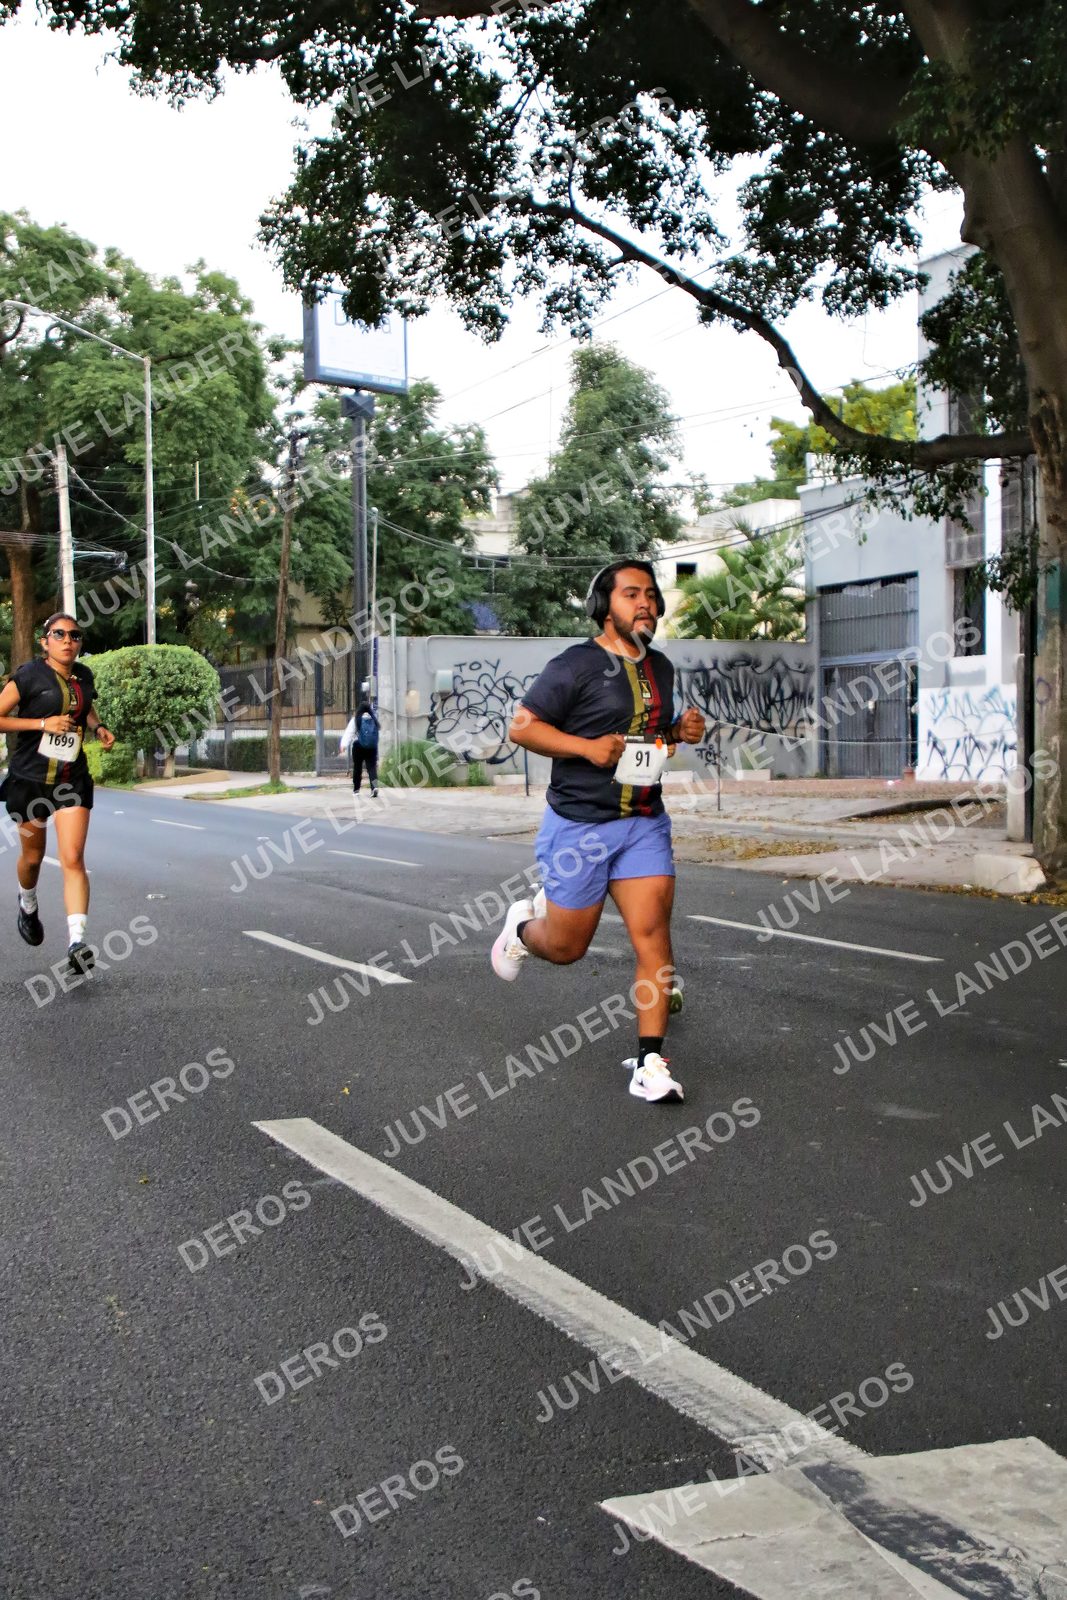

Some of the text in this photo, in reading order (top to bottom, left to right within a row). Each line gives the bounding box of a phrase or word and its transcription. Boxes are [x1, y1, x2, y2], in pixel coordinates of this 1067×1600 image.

[454, 658, 500, 677] TOY
[48, 734, 75, 748] 1699
[635, 750, 650, 767] 91
